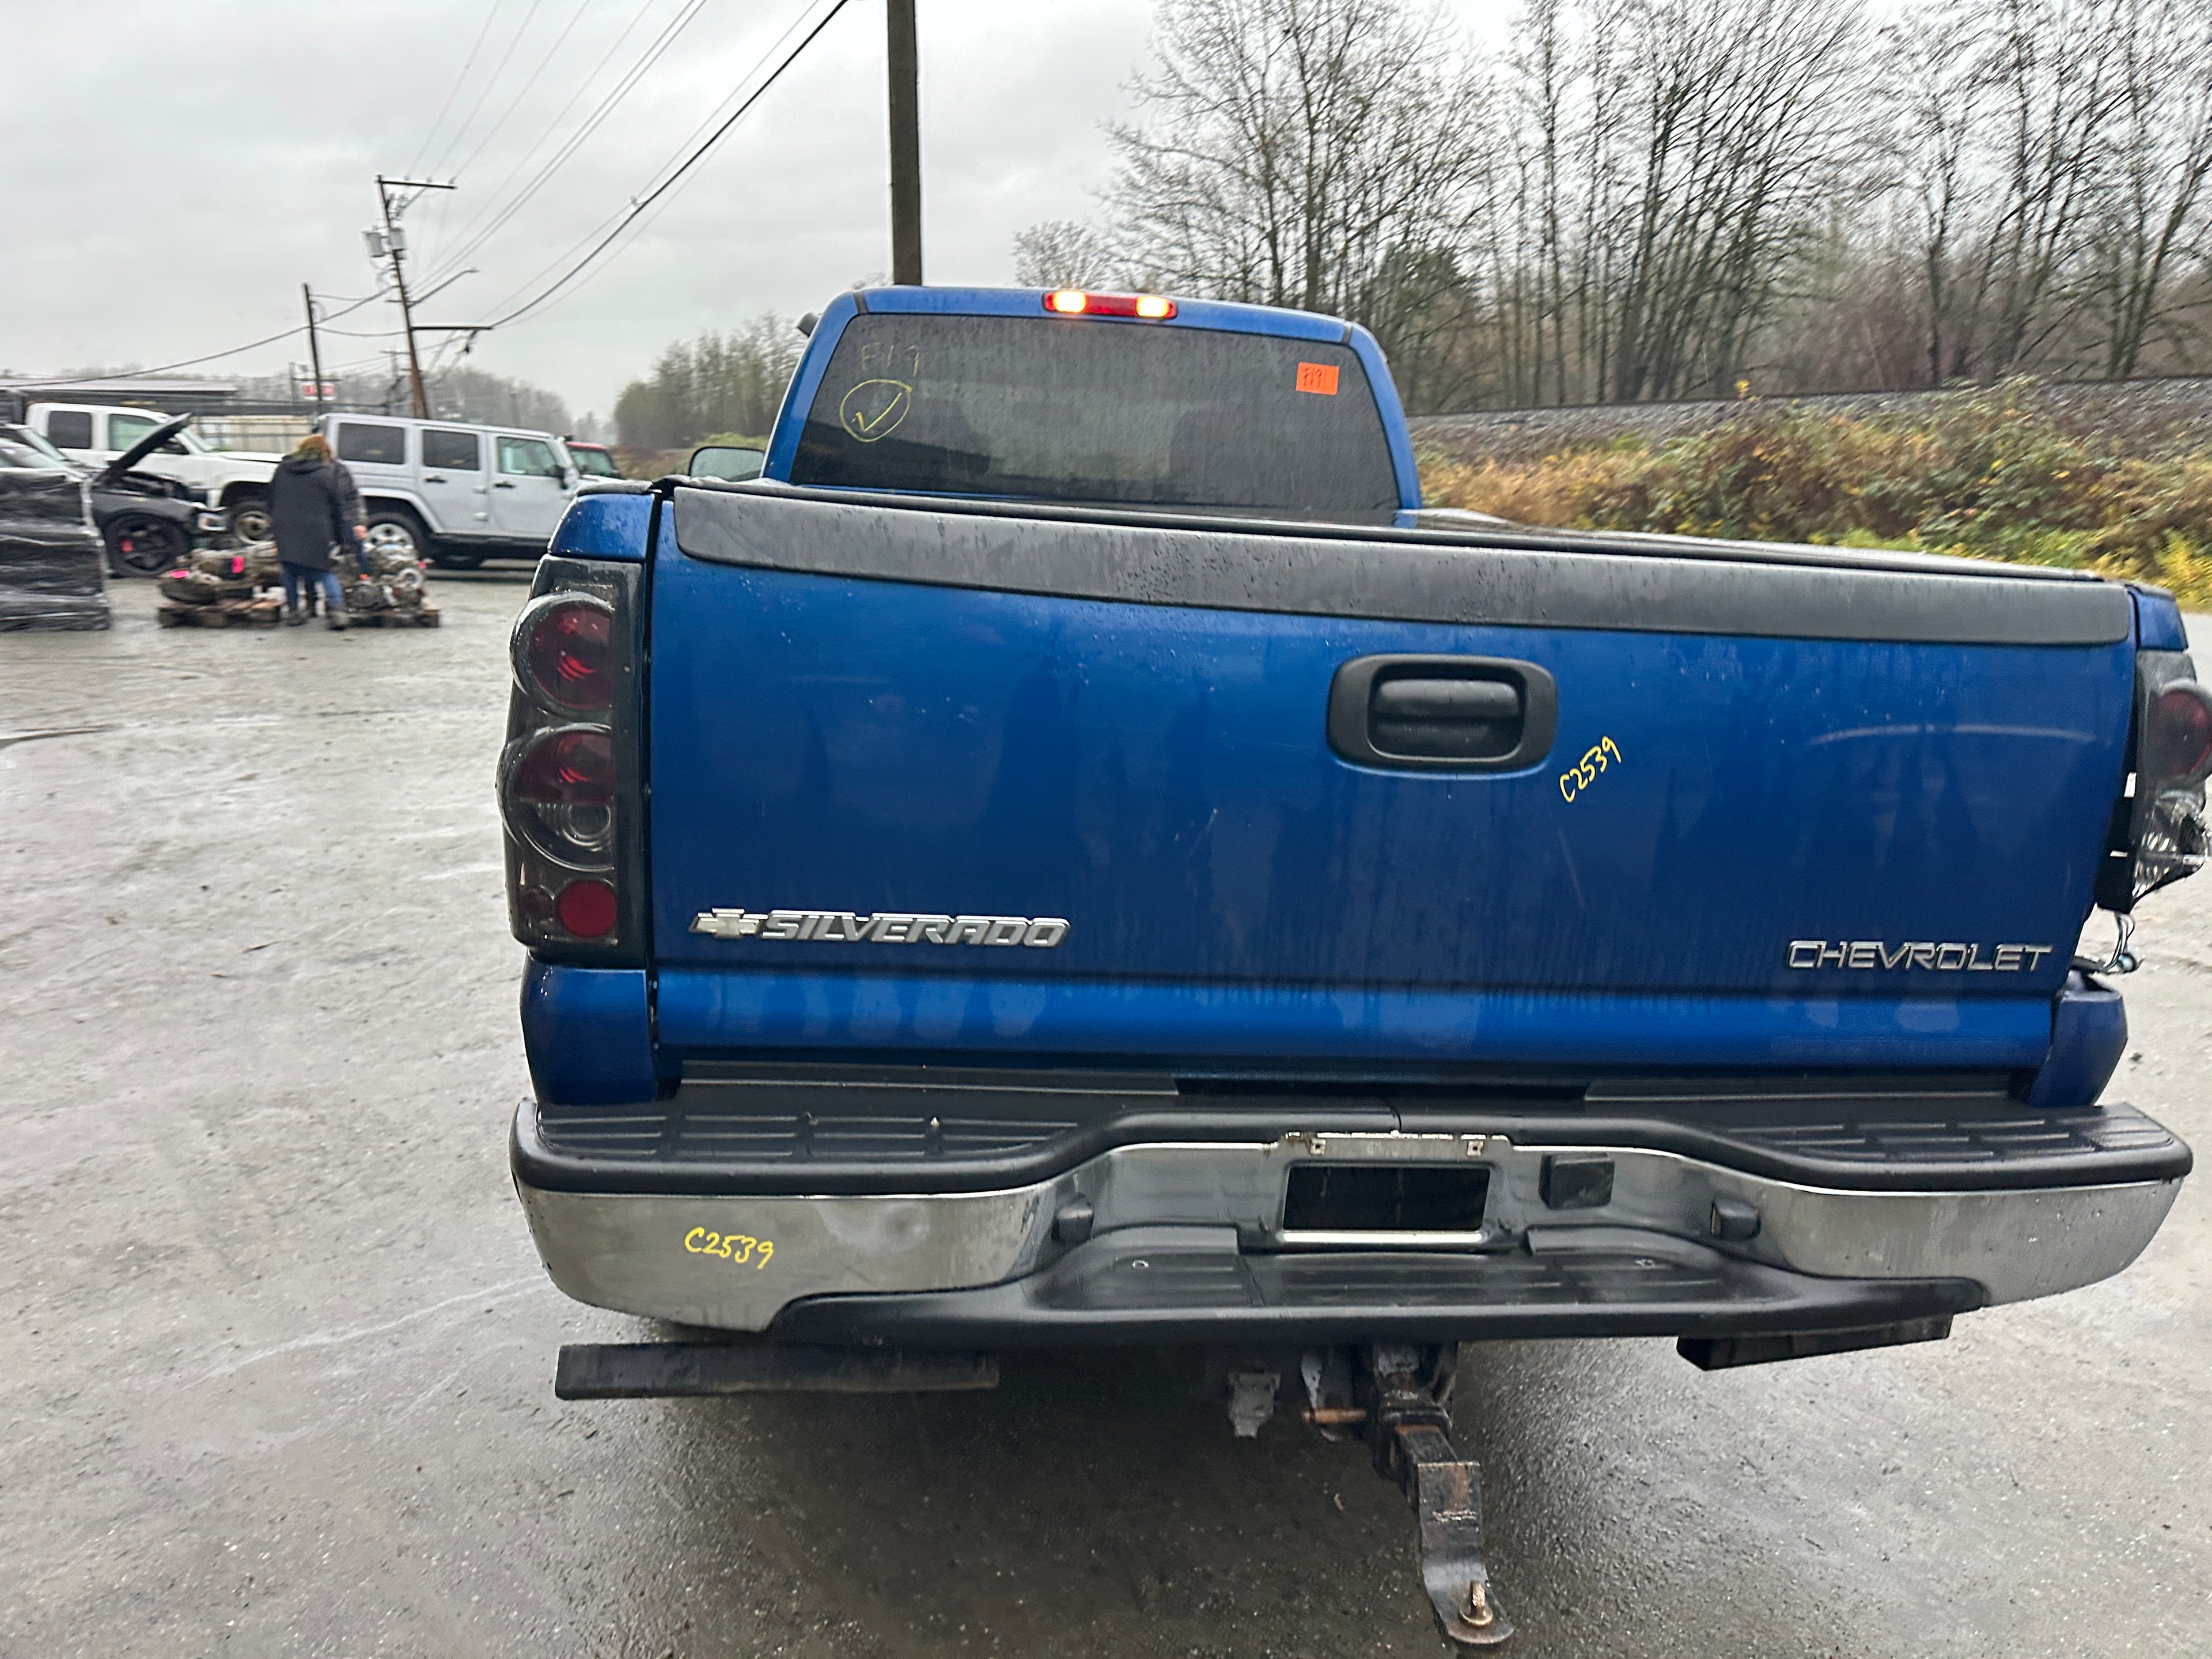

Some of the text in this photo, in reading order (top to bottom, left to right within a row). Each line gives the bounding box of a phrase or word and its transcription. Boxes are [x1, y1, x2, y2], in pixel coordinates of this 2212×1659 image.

[1559, 736, 1622, 803] C2539
[760, 910, 1070, 946] SILVERADO
[1789, 940, 2053, 971] CHEVROLET
[684, 1226, 774, 1270] C2539
